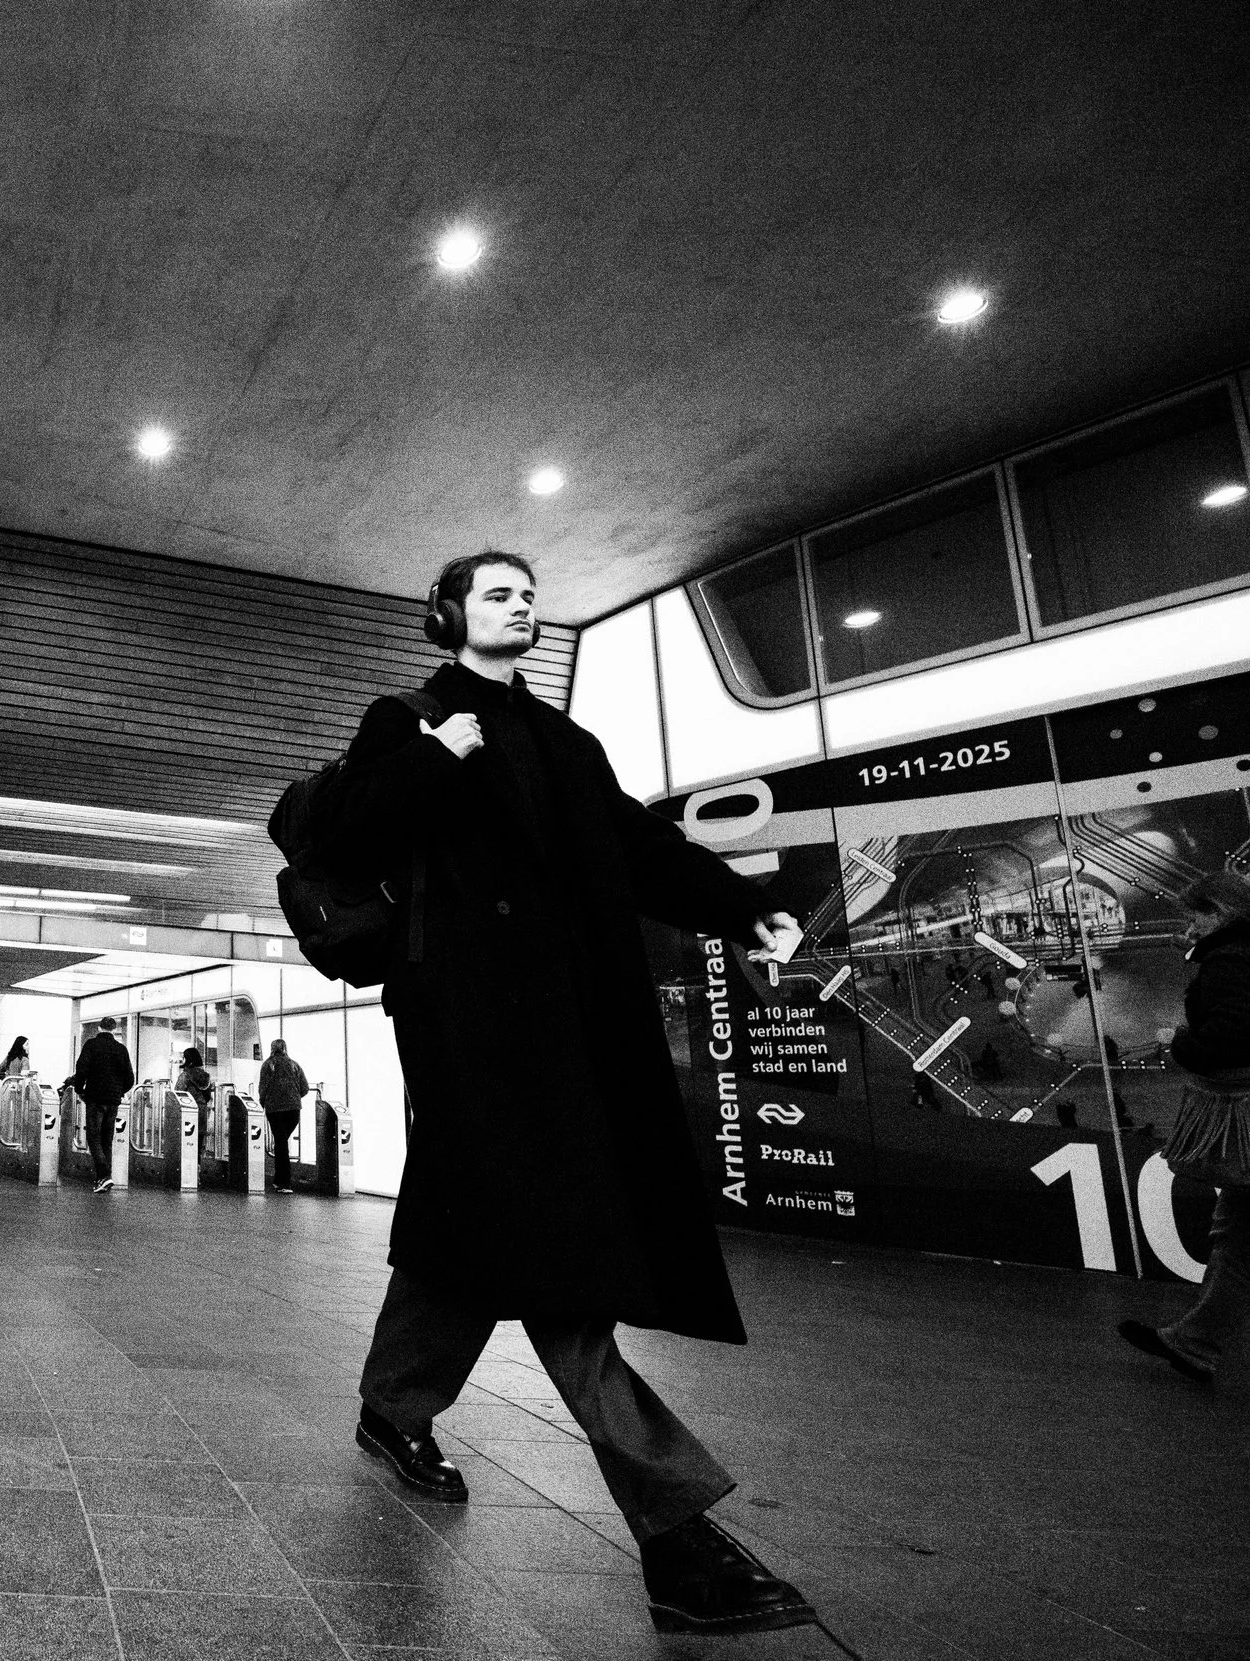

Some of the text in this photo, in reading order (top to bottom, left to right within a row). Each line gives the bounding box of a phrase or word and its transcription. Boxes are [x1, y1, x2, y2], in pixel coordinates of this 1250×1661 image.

[858, 740, 1011, 786] 19-11-2025
[990, 942, 1011, 960] Gouda
[747, 1005, 816, 1022] al 10 jaar
[748, 1022, 826, 1038] verbinden
[750, 1042, 828, 1058] wij samen
[697, 933, 748, 1207] Arnhem Centraa
[752, 1058, 848, 1073] stad en land
[760, 1144, 835, 1167] ProRail
[766, 1193, 833, 1212] Arnhem
